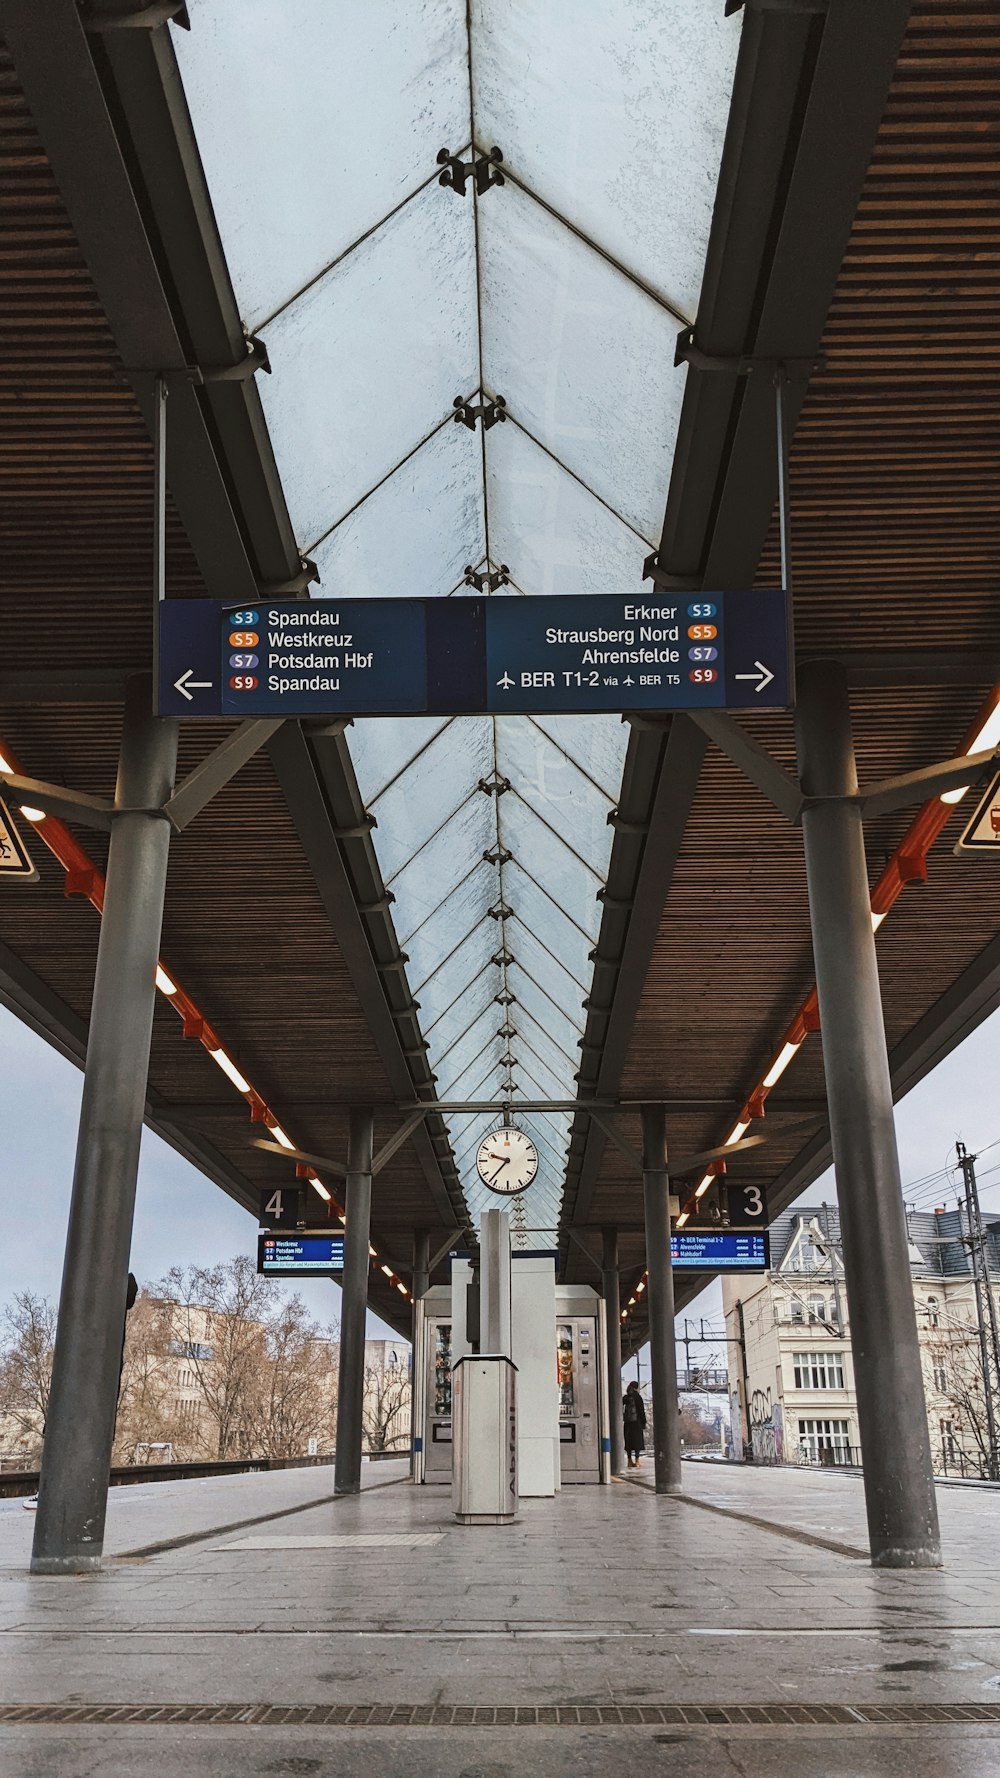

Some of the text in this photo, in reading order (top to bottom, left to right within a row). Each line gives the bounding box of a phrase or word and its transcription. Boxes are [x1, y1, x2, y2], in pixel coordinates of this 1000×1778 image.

[236, 611, 339, 628] S3 Spandau
[625, 605, 710, 619] Erkner S3
[236, 632, 352, 647] S5 Westkreuz
[546, 626, 711, 645] Strausberg Nord S5
[235, 653, 373, 668] S7 Potsdam Hbf
[582, 648, 712, 664] Ahrensfelde S7
[235, 676, 339, 693] S9 Spandau
[521, 670, 712, 687] BER T1-2 via BER T5 S9
[265, 1190, 284, 1219] 4
[743, 1186, 763, 1216] 3
